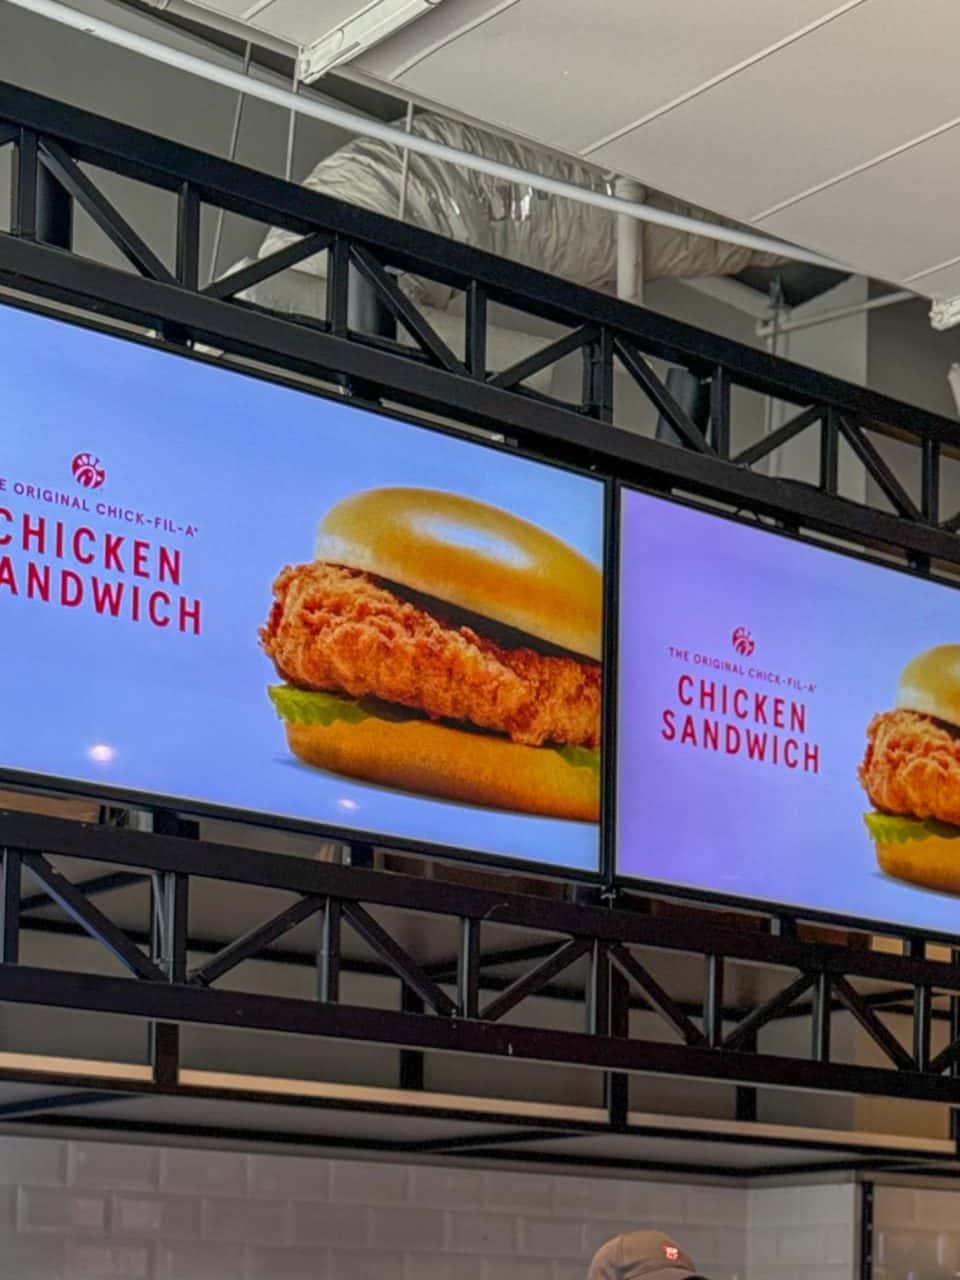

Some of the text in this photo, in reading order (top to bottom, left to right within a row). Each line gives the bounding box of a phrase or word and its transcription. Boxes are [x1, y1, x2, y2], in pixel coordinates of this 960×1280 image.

[14, 482, 90, 512] ORIGINAL
[0, 555, 201, 636] ANDWICH
[669, 647, 690, 663] THE
[694, 653, 744, 676] ORIGINAL
[677, 674, 807, 734] CHICKEN
[661, 709, 820, 775] SANDWICH
